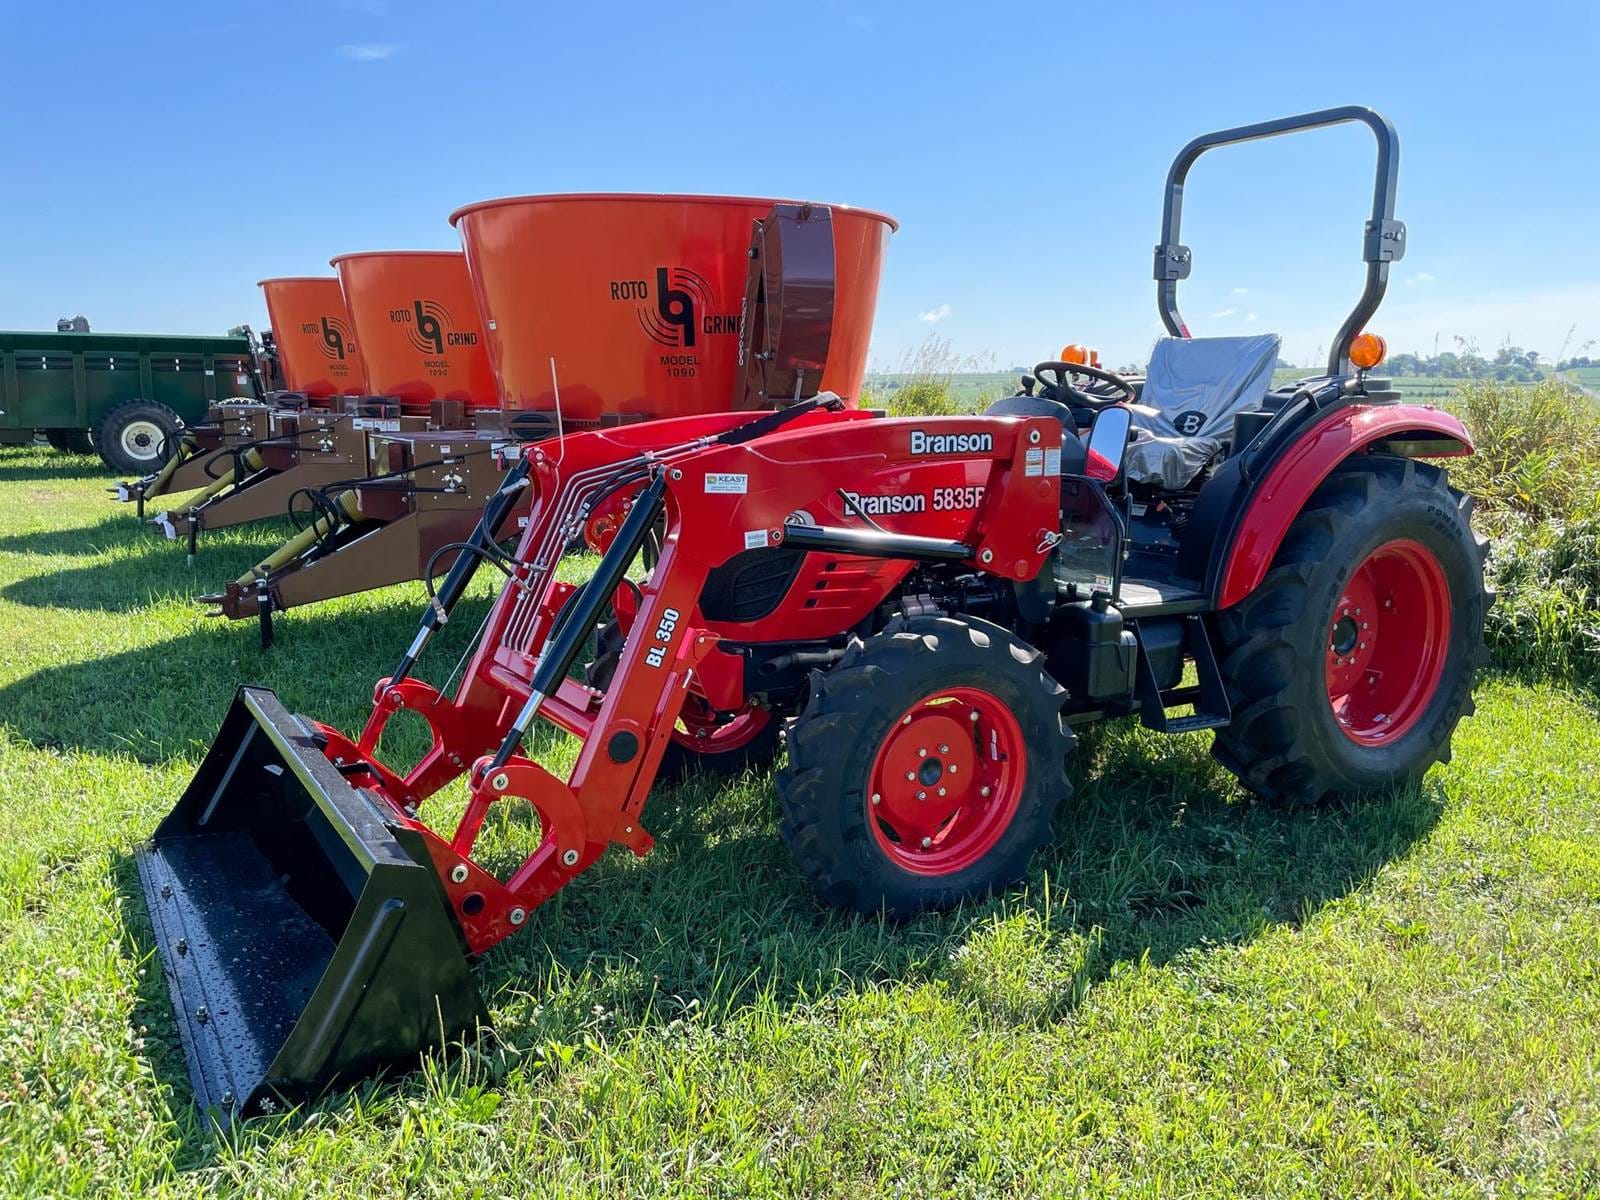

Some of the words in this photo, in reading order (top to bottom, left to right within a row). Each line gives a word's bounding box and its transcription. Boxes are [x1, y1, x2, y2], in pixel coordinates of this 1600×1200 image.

[610, 280, 648, 300] ROTO
[389, 309, 411, 323] ROTO
[447, 332, 478, 346] GRIND
[424, 360, 450, 368] MODEL
[660, 355, 700, 366] MODEL
[666, 367, 696, 377] 1090
[911, 431, 993, 454] Branson
[844, 490, 927, 517] Branson
[655, 608, 680, 643] 350
[645, 647, 667, 668] BL
